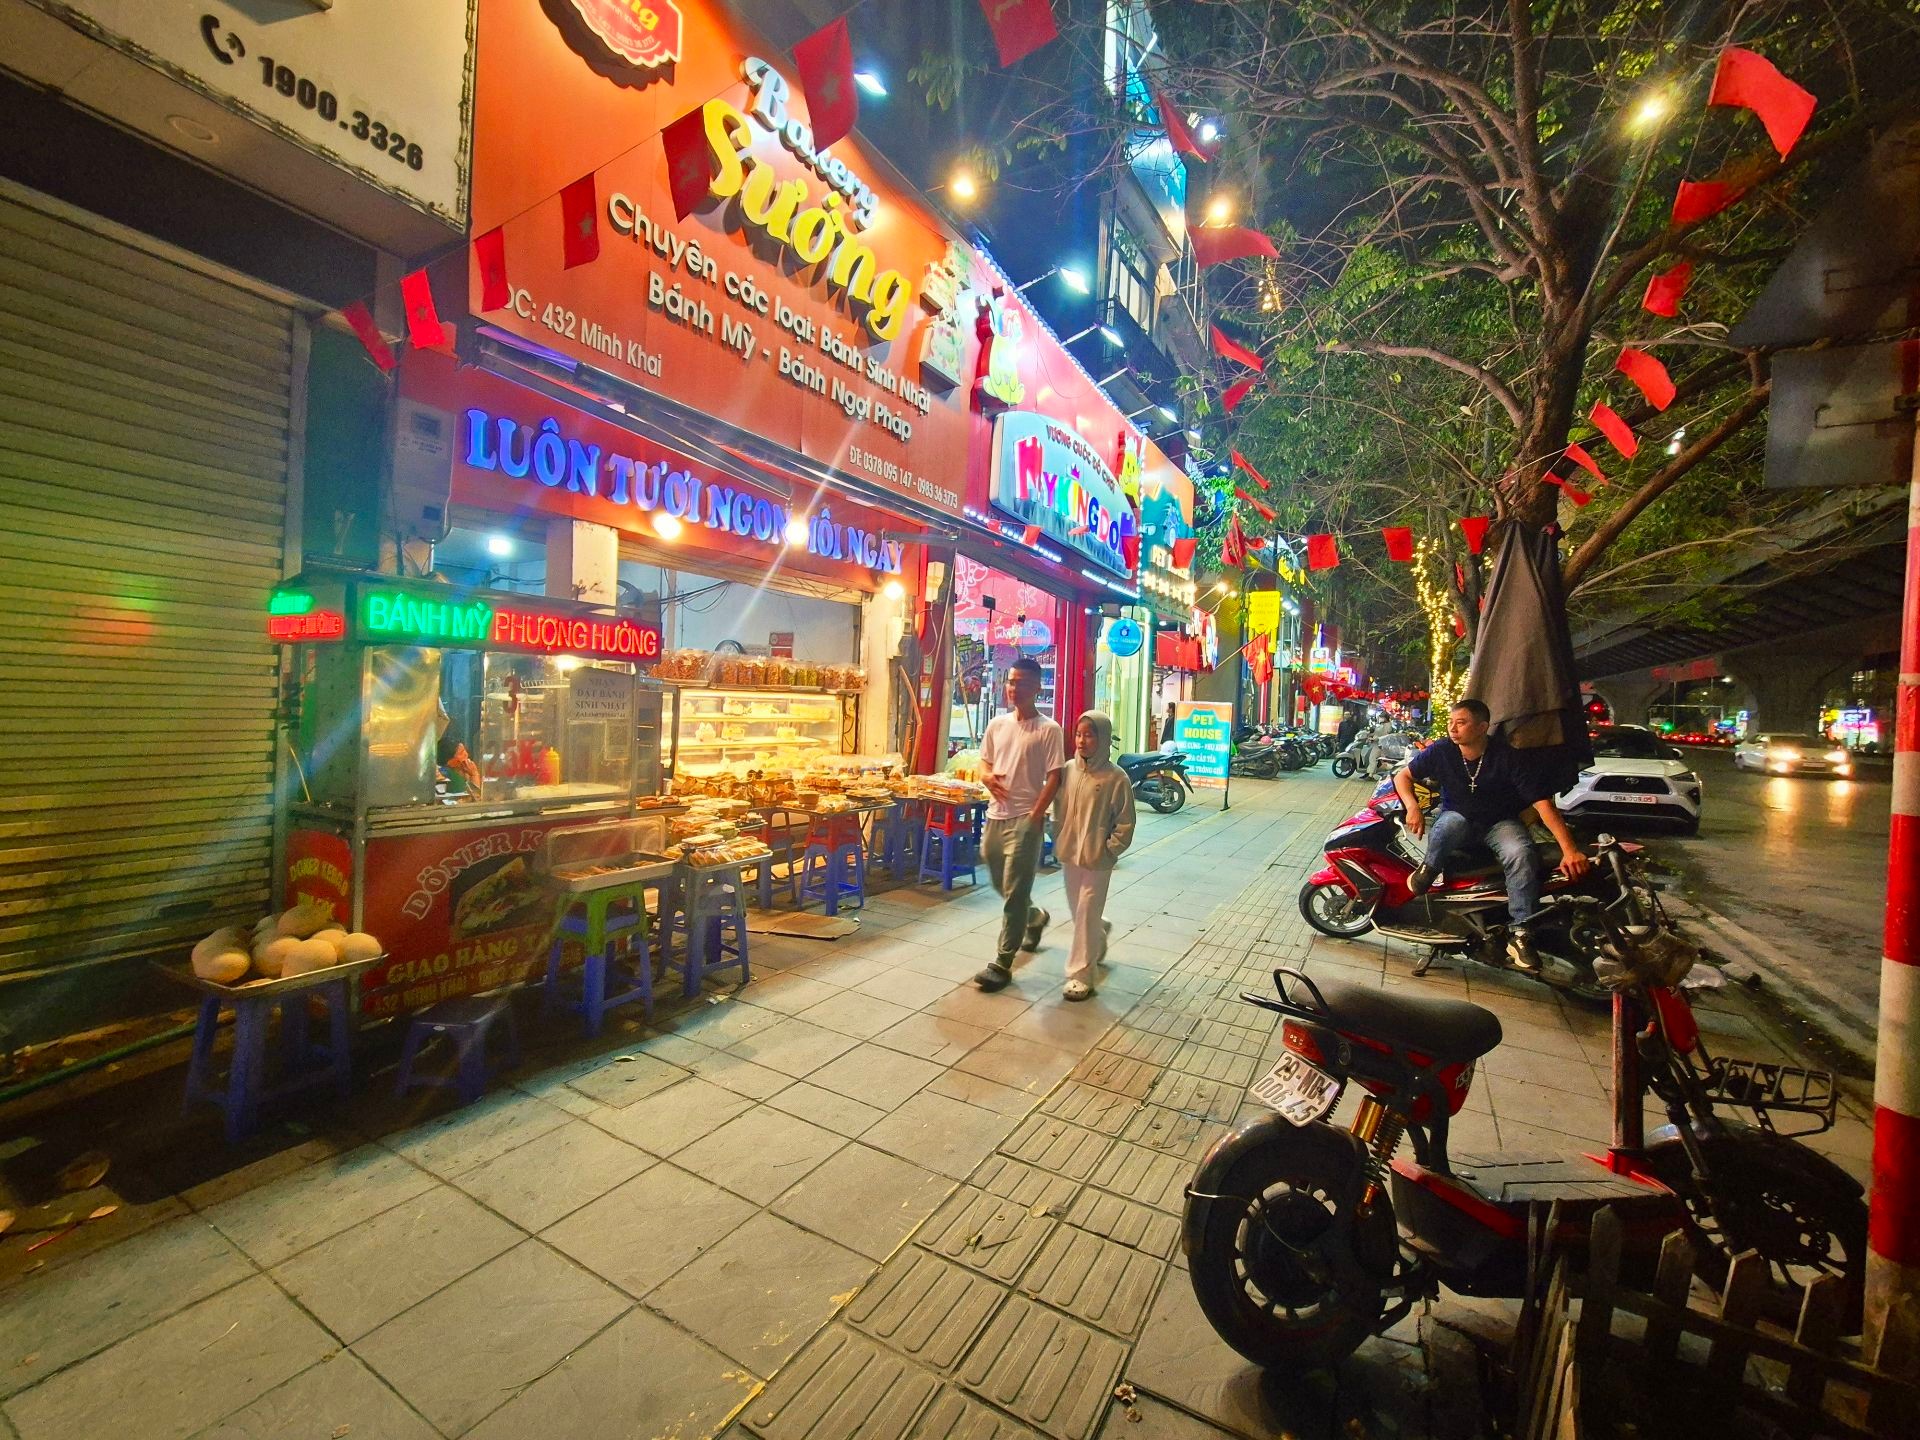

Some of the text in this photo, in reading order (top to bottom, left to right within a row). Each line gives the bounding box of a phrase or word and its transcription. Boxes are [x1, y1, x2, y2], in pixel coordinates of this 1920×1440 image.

[258, 56, 423, 171] 1900.3326
[703, 98, 912, 341] Sương
[541, 303, 576, 340] 432
[581, 318, 623, 360] Minh
[627, 339, 662, 378] Khai
[609, 192, 931, 417] Chuyên các loại: Bánh Sinh Nhật
[649, 270, 714, 335] Bánh
[721, 313, 757, 360] Mỳ
[779, 345, 826, 395] Bánh
[831, 376, 871, 420] Ngọt
[874, 402, 912, 442] Pháp
[466, 409, 601, 497] LUÔN
[605, 453, 702, 524] TƯƠI
[705, 484, 793, 545] NGON
[863, 452, 883, 476] 0378
[883, 461, 898, 482] 095
[899, 468, 912, 488] 147
[917, 477, 934, 499] 0983
[943, 489, 958, 509] 3773
[369, 593, 448, 636] BÁNH
[452, 602, 493, 639] MỲ
[494, 612, 588, 651] PHƯỢNG
[1184, 727, 1222, 740] HOUSE
[1192, 714, 1214, 726] PET
[402, 832, 513, 921] DÖNER
[387, 953, 450, 985] GIAO
[455, 939, 518, 969] HÀNG
